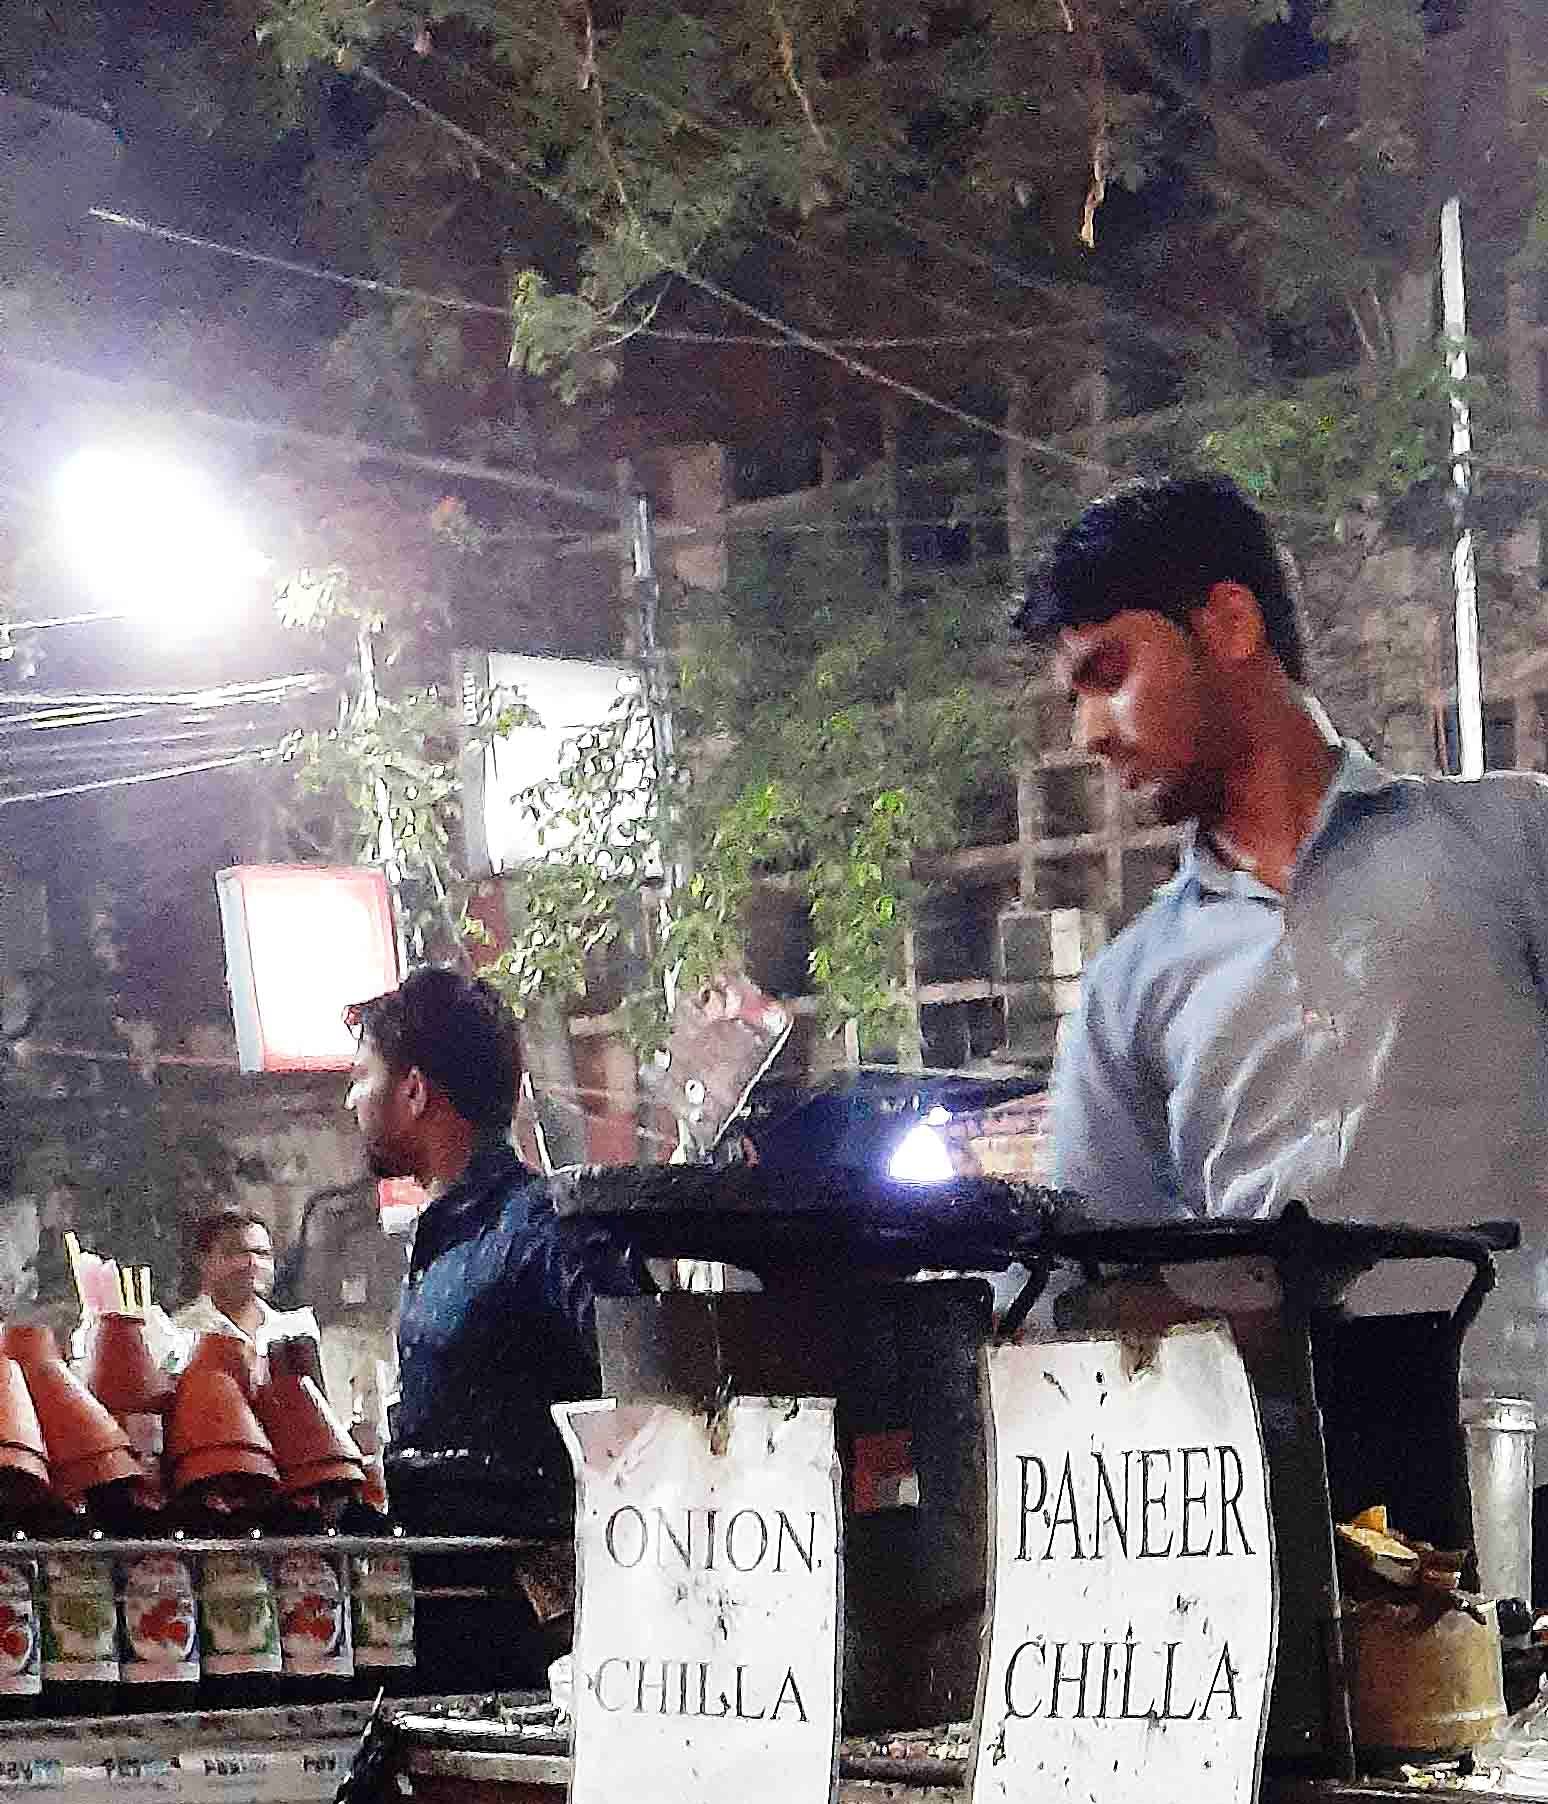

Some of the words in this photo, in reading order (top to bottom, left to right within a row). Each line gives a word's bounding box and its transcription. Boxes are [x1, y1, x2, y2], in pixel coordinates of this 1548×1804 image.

[605, 1504, 817, 1574] ONION
[1015, 1444, 1256, 1562] PANEER
[595, 1656, 811, 1722] CHILLA
[1005, 1640, 1242, 1721] CHILLA
